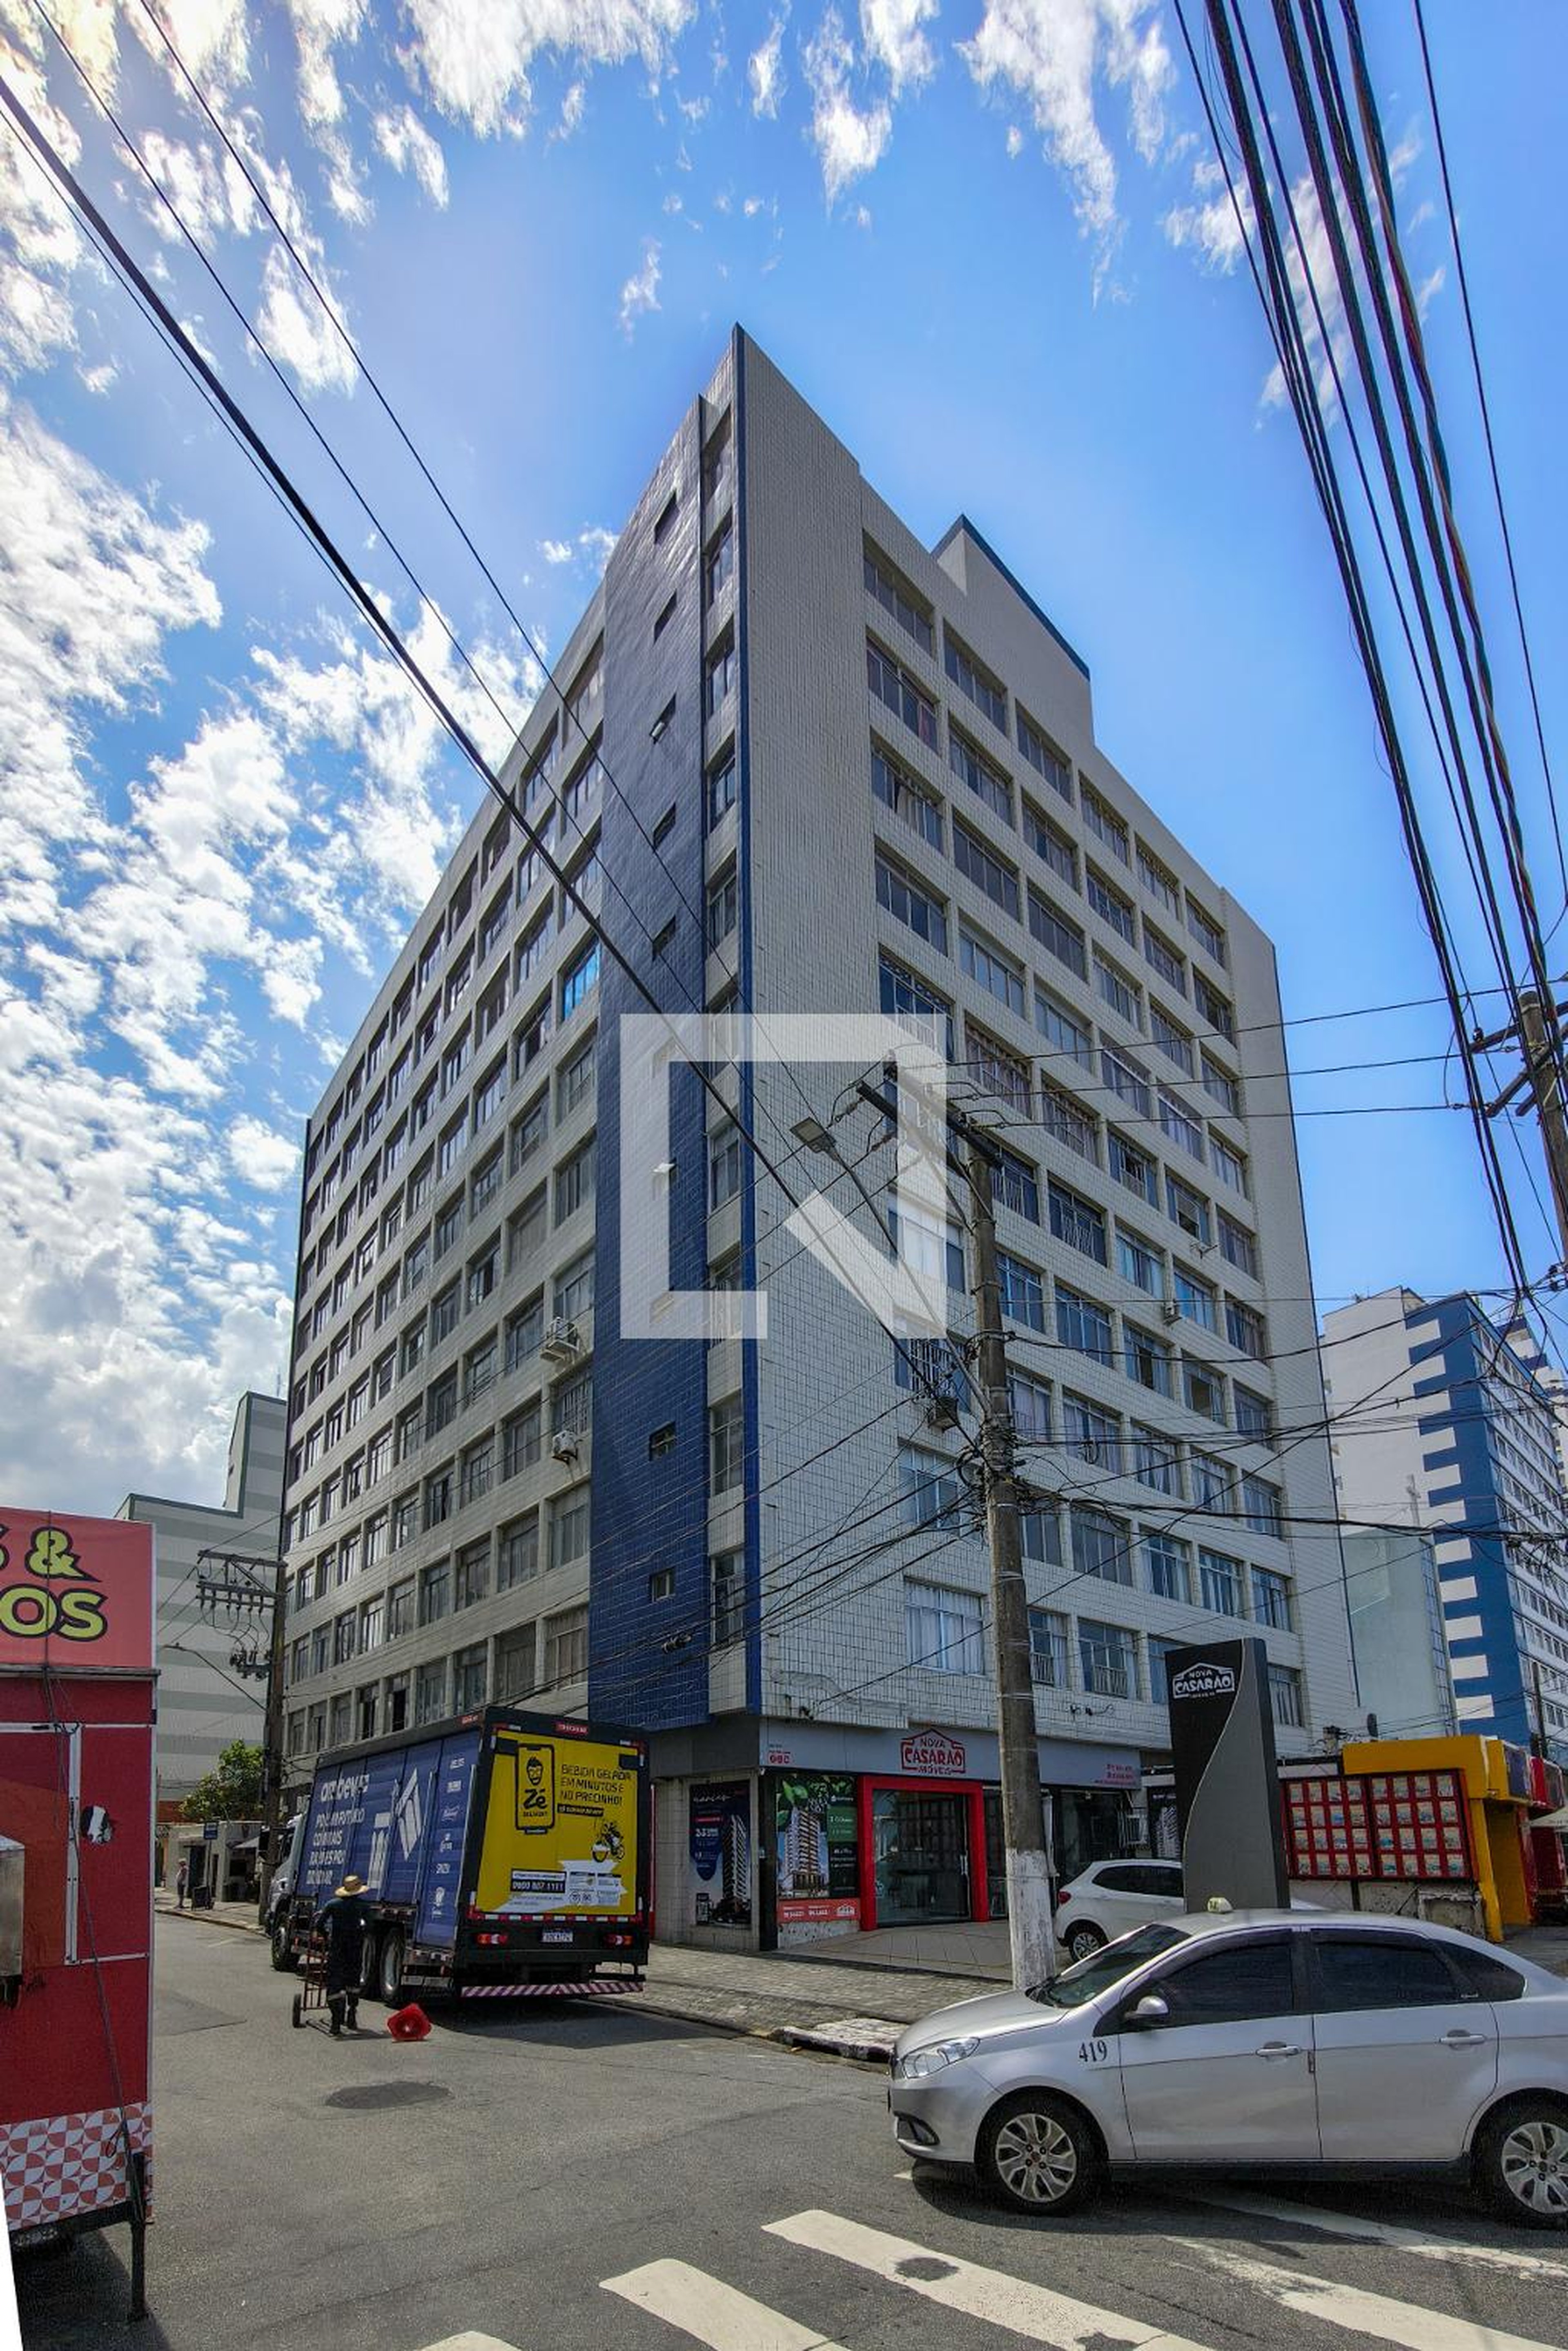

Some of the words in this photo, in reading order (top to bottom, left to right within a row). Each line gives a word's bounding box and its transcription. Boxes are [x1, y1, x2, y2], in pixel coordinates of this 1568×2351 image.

[24, 1526, 102, 1582] &
[1190, 1669, 1213, 1678] NOVA
[921, 1736, 945, 1748] NOVA
[561, 1764, 595, 1777] BEBIDA
[597, 1768, 631, 1781] GELADA
[575, 1779, 617, 1792] MINUTOS
[523, 1789, 548, 1809] Zé
[1079, 2040, 1107, 2062] 419
